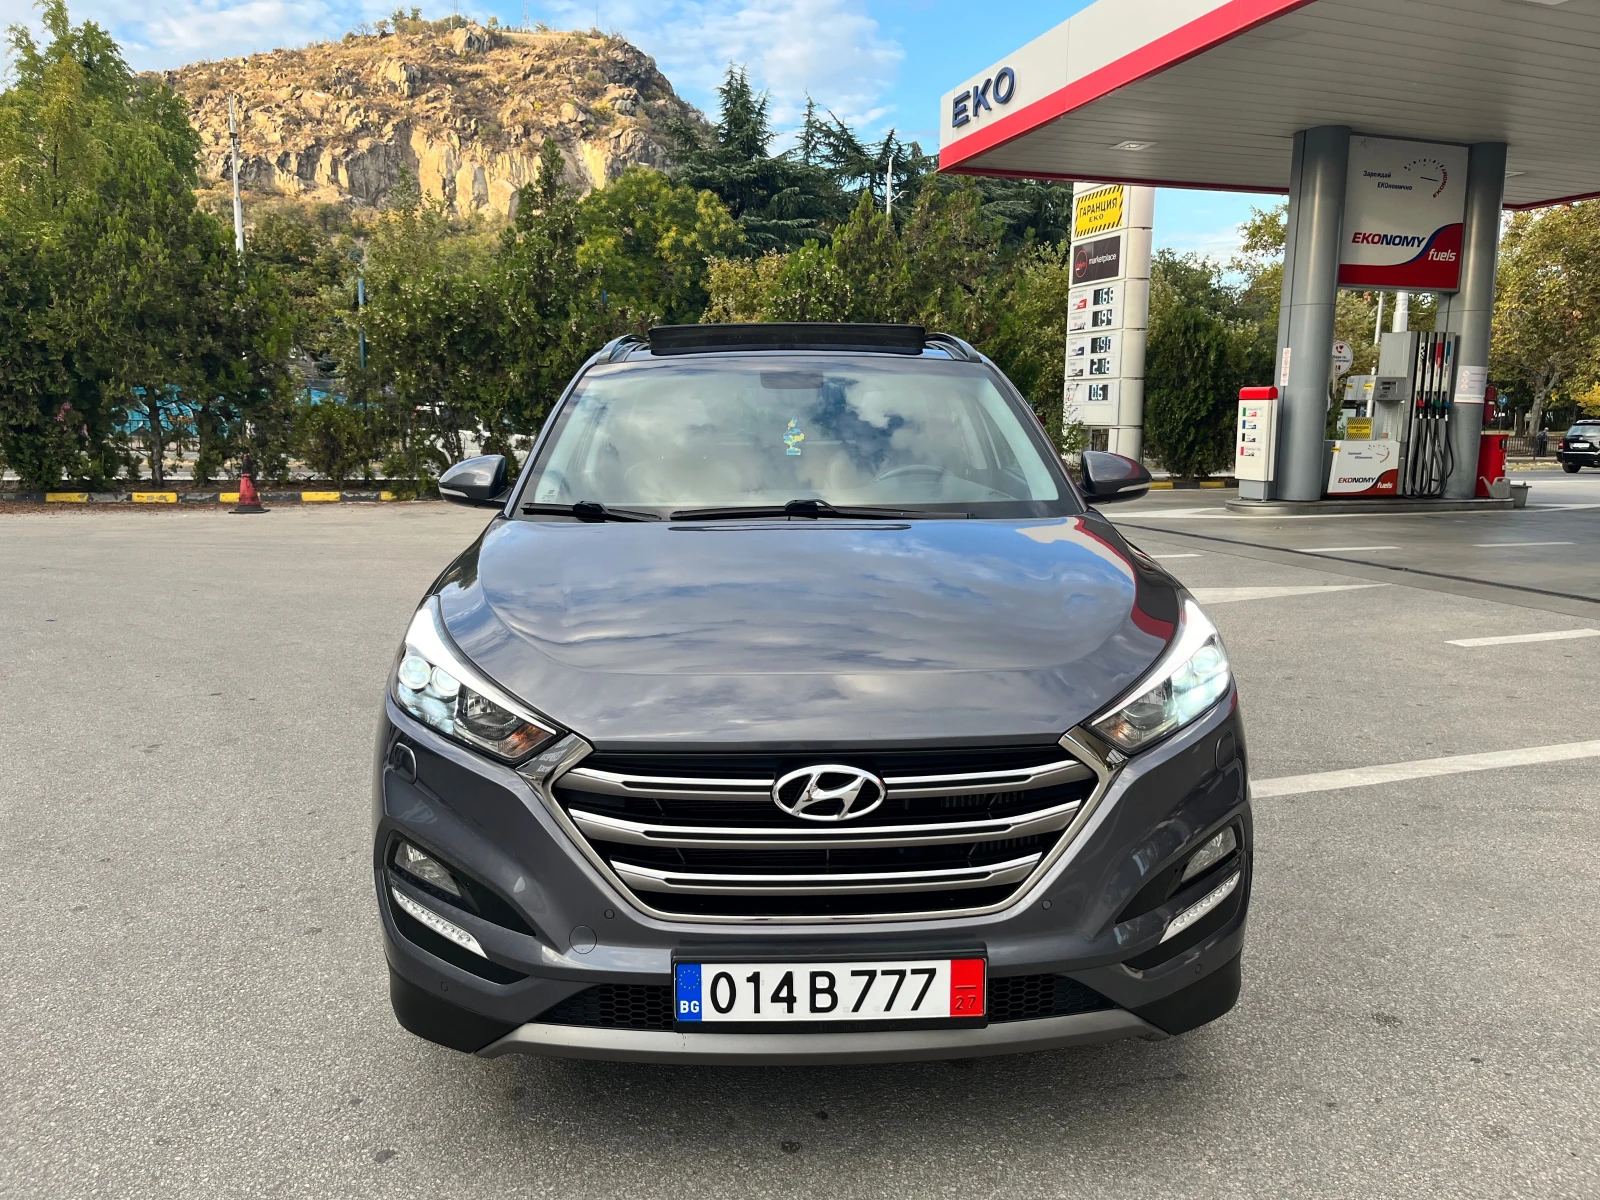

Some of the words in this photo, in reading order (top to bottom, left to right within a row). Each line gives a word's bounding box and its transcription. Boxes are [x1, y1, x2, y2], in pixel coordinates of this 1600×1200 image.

[952, 66, 1016, 129] EKO
[1079, 197, 1118, 218] ГАРАНЦИЯ
[1351, 231, 1427, 248] EKONOMY
[1088, 253, 1117, 265] marketplace
[1427, 248, 1457, 262] fuels
[680, 1000, 700, 1013] BG
[955, 994, 977, 1010] 27
